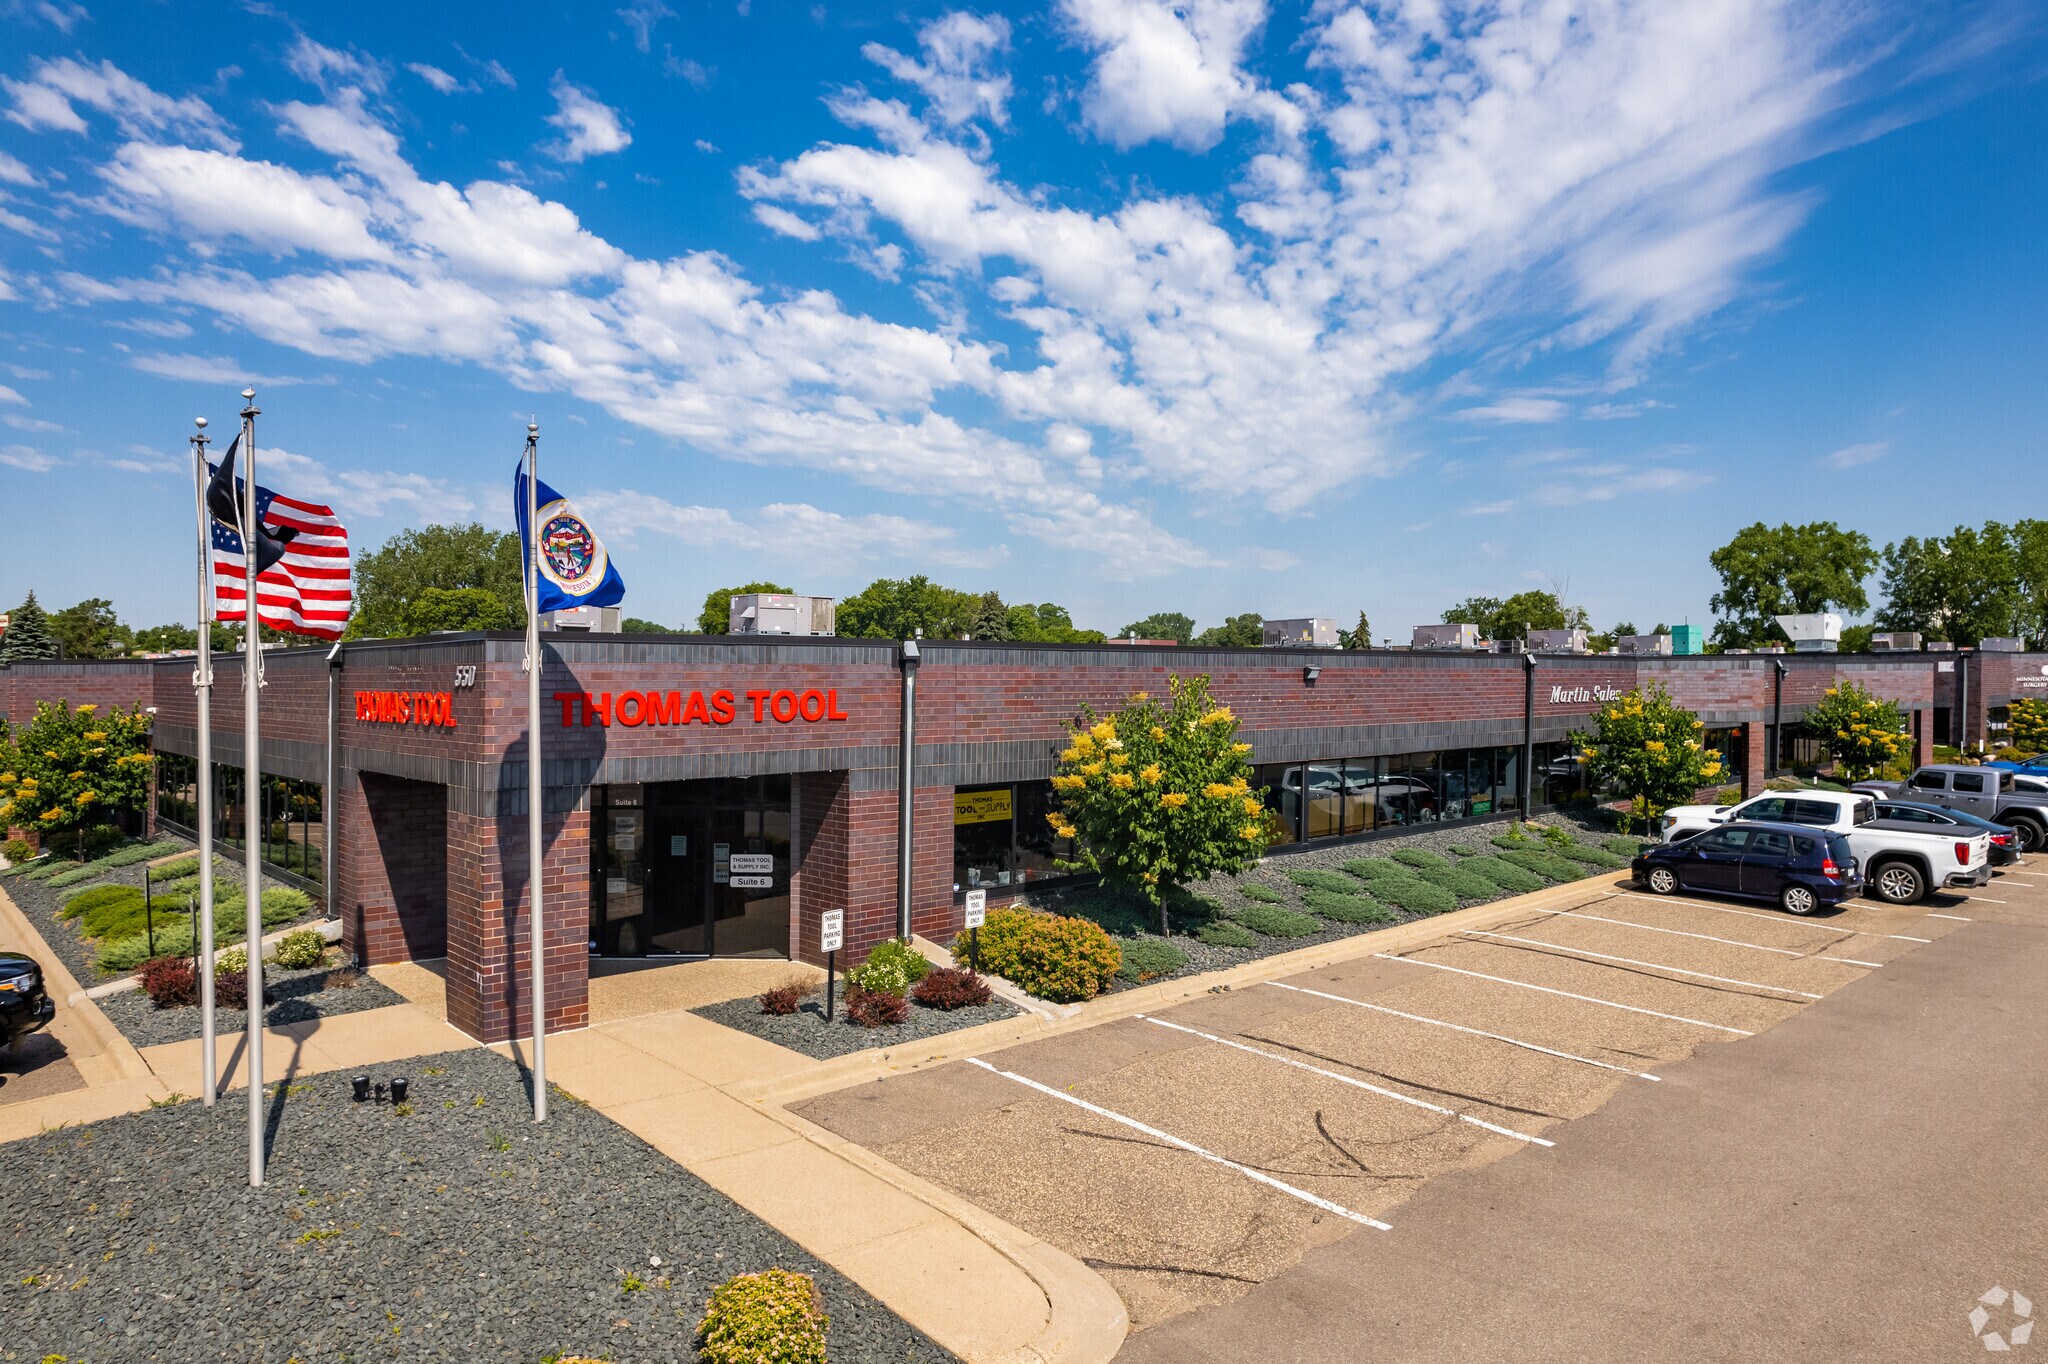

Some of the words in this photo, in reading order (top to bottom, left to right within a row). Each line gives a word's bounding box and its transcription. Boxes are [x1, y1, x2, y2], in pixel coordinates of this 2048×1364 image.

[455, 665, 476, 687] 550
[1550, 686, 1590, 702] Martin
[354, 691, 410, 724] THOMAS
[412, 691, 457, 727] TOOL
[555, 690, 735, 727] THOMAS
[747, 689, 848, 722] TOOL
[956, 806, 978, 814] TOOL
[986, 802, 1010, 812] SUPPLY
[824, 914, 840, 922] THOMAS
[824, 930, 840, 939] PARKING
